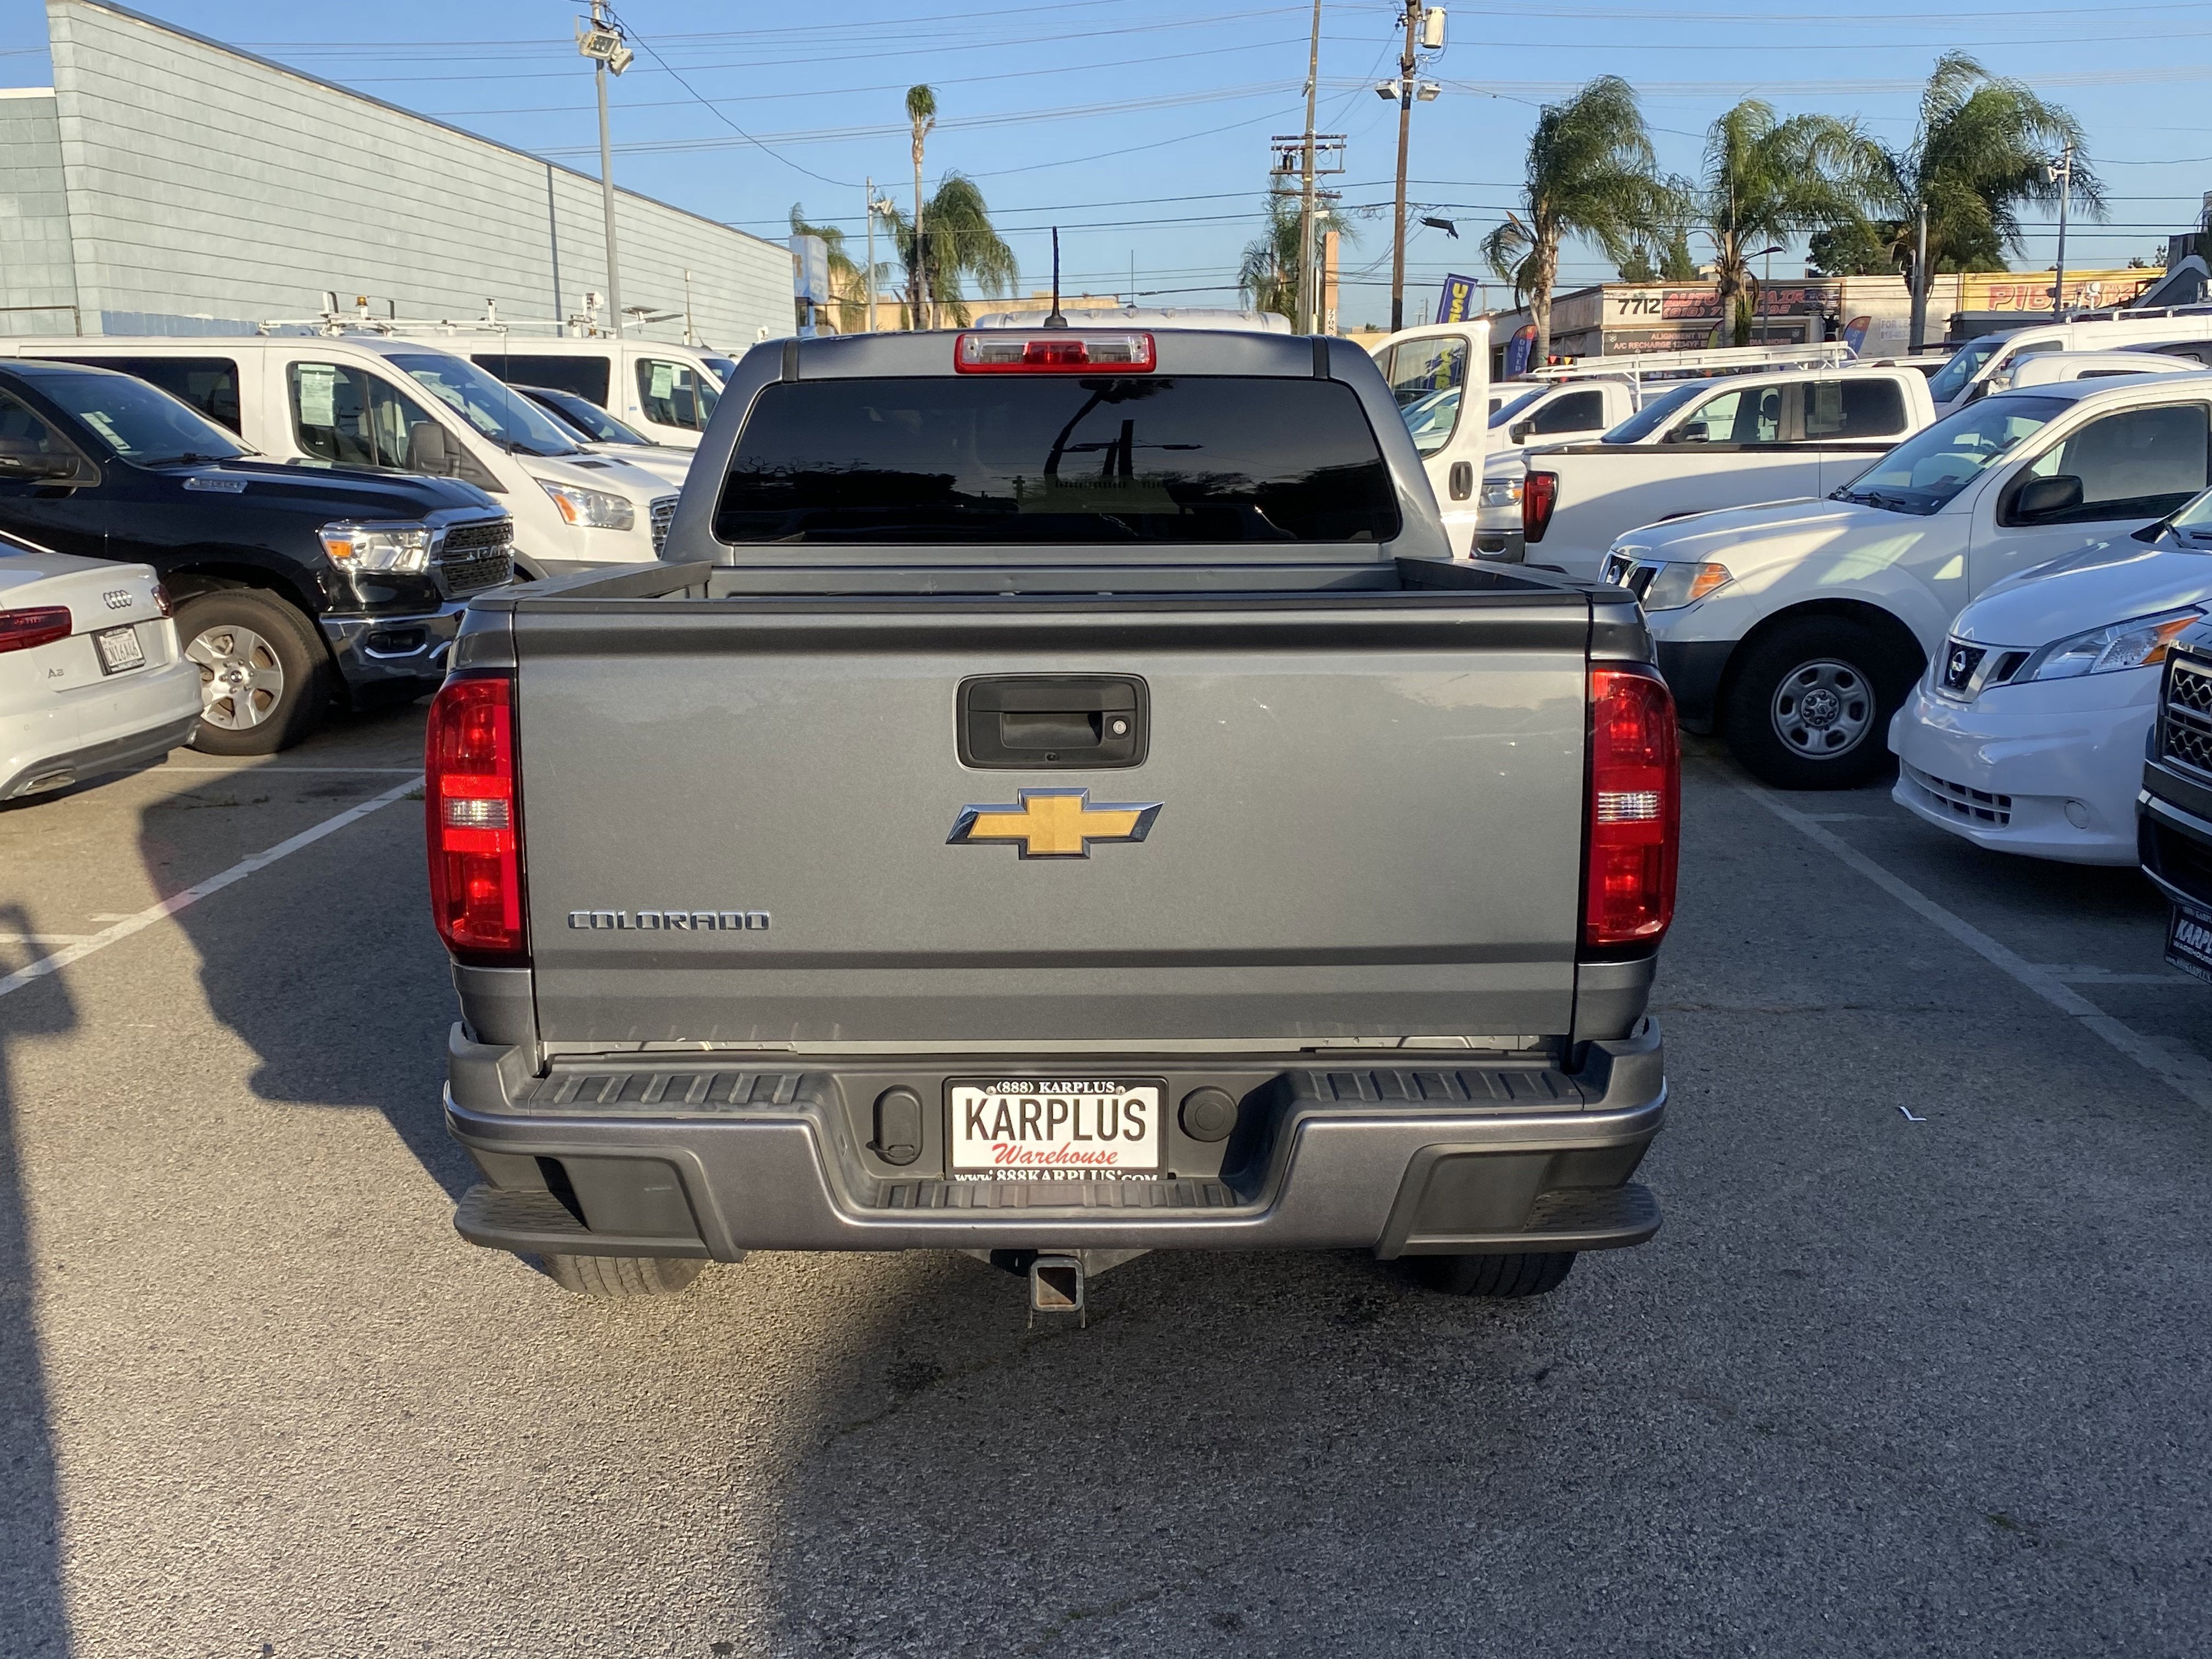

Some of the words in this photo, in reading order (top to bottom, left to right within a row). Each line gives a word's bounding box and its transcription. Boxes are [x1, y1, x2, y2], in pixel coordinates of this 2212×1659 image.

[1448, 283, 1468, 323] USE
[1618, 298, 1661, 314] 7712
[1663, 292, 1720, 307] AUTO
[1881, 320, 1897, 329] FOR
[1628, 341, 1671, 349] RECHARGE
[568, 911, 770, 930] COLORADO
[996, 1081, 1034, 1093] (888)
[1039, 1081, 1115, 1093] KARPLUS
[966, 1098, 1146, 1141] KARPLUS
[991, 1142, 1118, 1165] Warehouse
